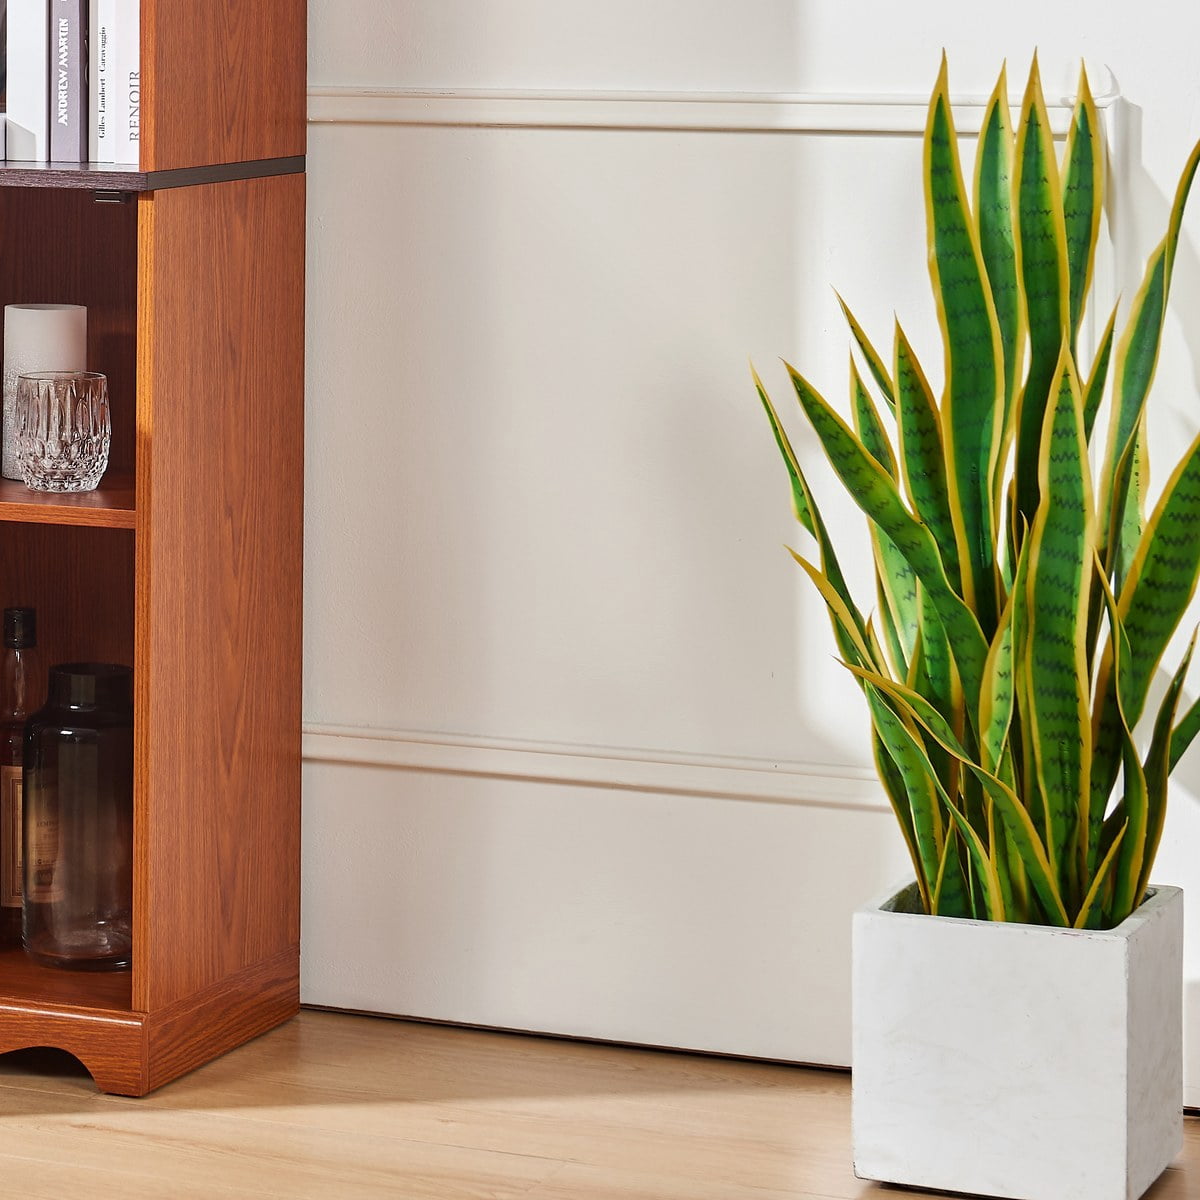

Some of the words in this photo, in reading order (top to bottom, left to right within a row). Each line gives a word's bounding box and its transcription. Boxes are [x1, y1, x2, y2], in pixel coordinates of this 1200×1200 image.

[57, 17, 69, 68] MARTIN
[98, 26, 107, 73] Caravaggio
[57, 69, 69, 127] ANDREW
[98, 78, 106, 113] Lambert
[128, 71, 140, 141] RENOIR
[98, 116, 106, 139] Gilles
